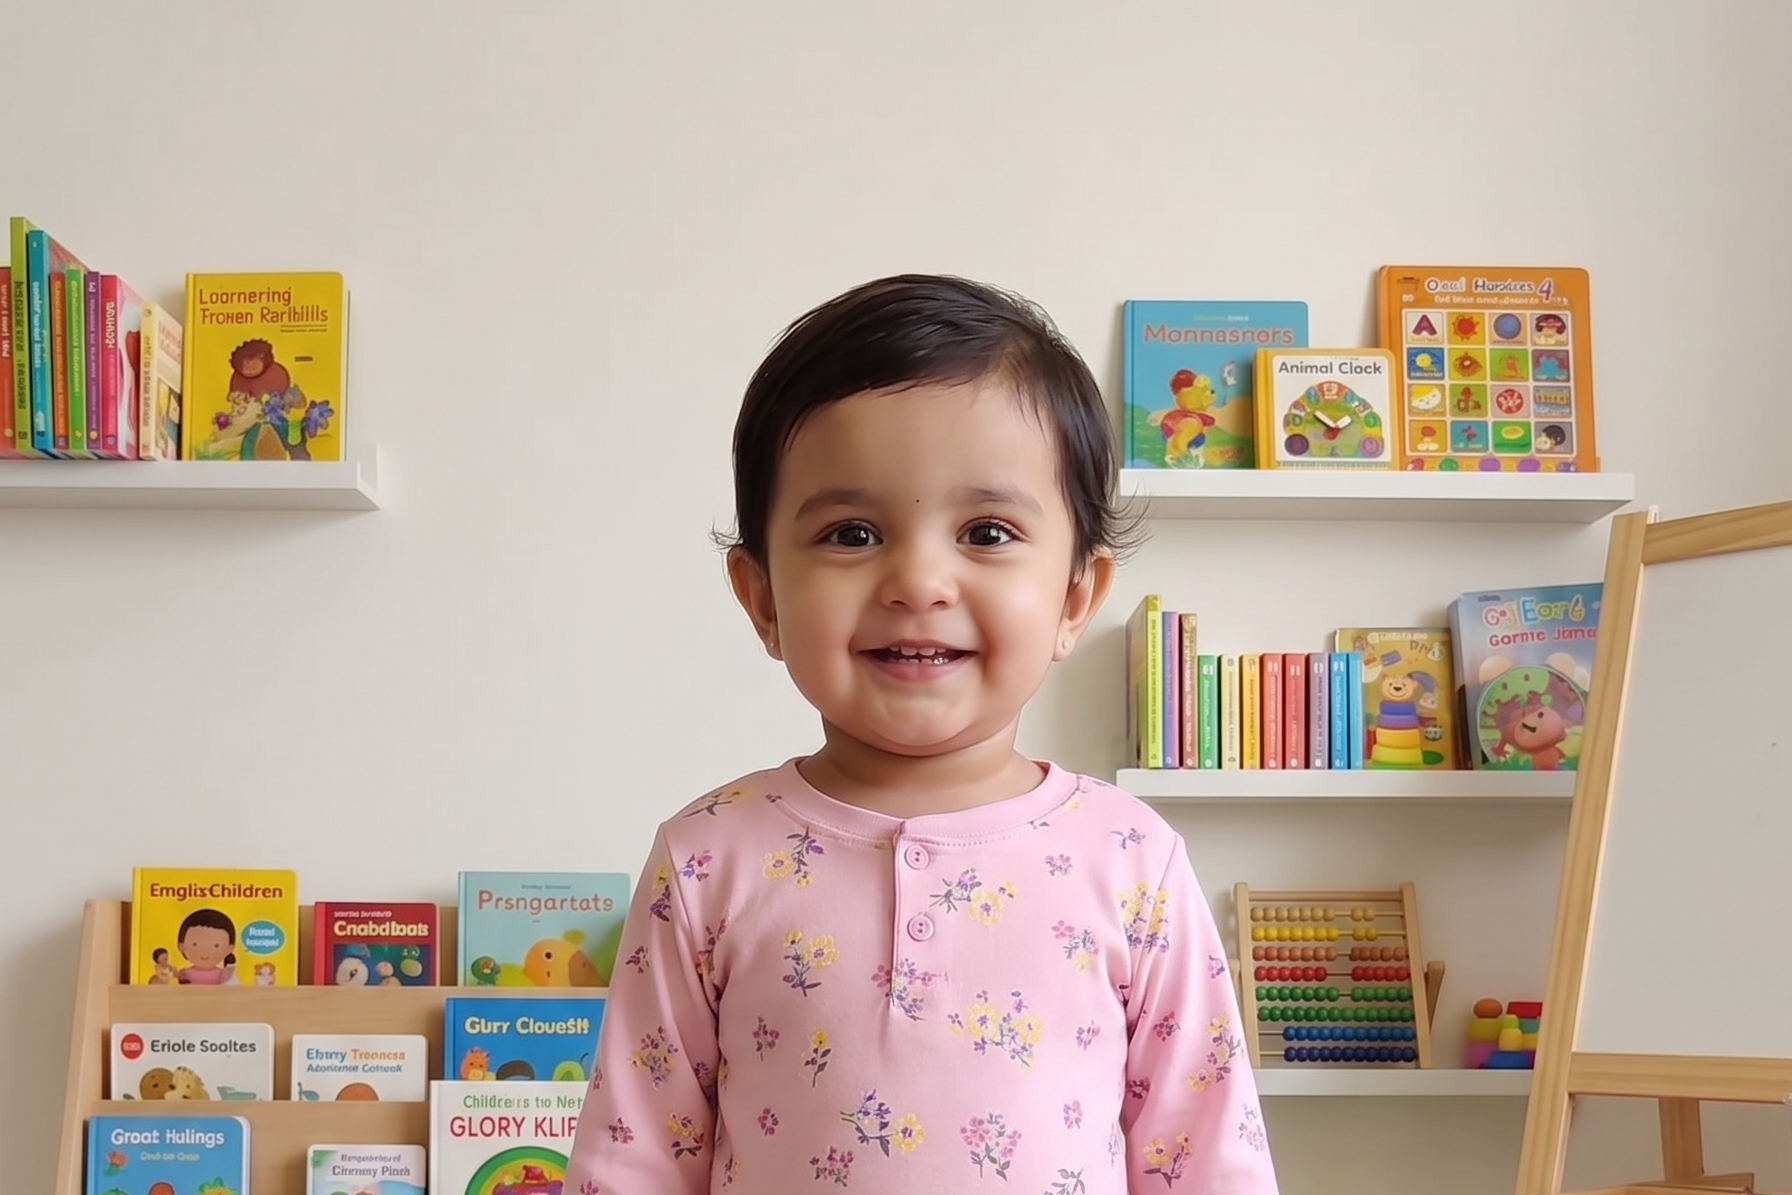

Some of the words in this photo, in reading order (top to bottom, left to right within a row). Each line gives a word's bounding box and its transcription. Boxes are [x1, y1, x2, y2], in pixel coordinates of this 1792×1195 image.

[1279, 361, 1333, 374] Animal
[151, 1040, 196, 1052] Eriole
[450, 1116, 526, 1137] GLORY
